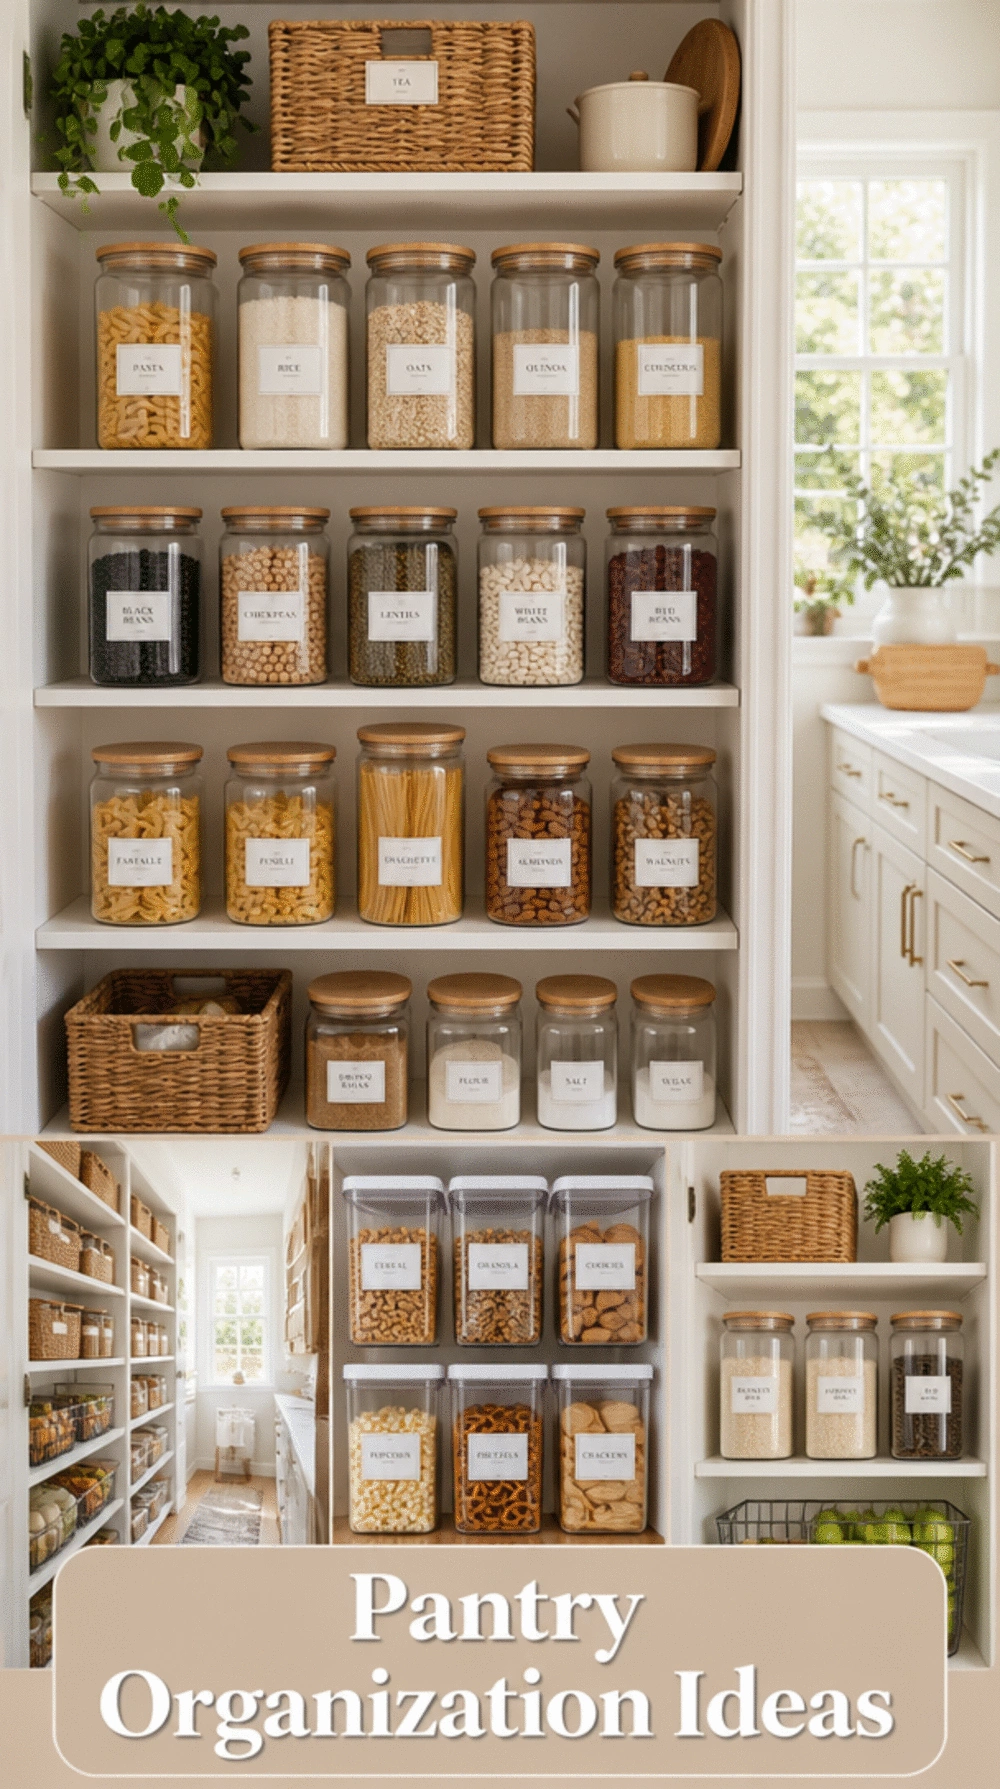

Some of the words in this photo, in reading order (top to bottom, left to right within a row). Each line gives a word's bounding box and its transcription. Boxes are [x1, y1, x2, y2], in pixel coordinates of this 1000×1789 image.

[392, 78, 411, 87] TEA
[132, 364, 164, 373] PASTA
[277, 364, 301, 373] RICE
[405, 364, 432, 373] OATS
[525, 364, 567, 373] QUINOA
[122, 606, 154, 615] BLACK
[380, 610, 420, 619] LENTILS
[514, 607, 547, 616] WHITE
[122, 616, 154, 625] BEANS
[516, 616, 548, 625] BEANS
[645, 857, 691, 866] WALNUTS
[565, 1077, 587, 1086] SALT
